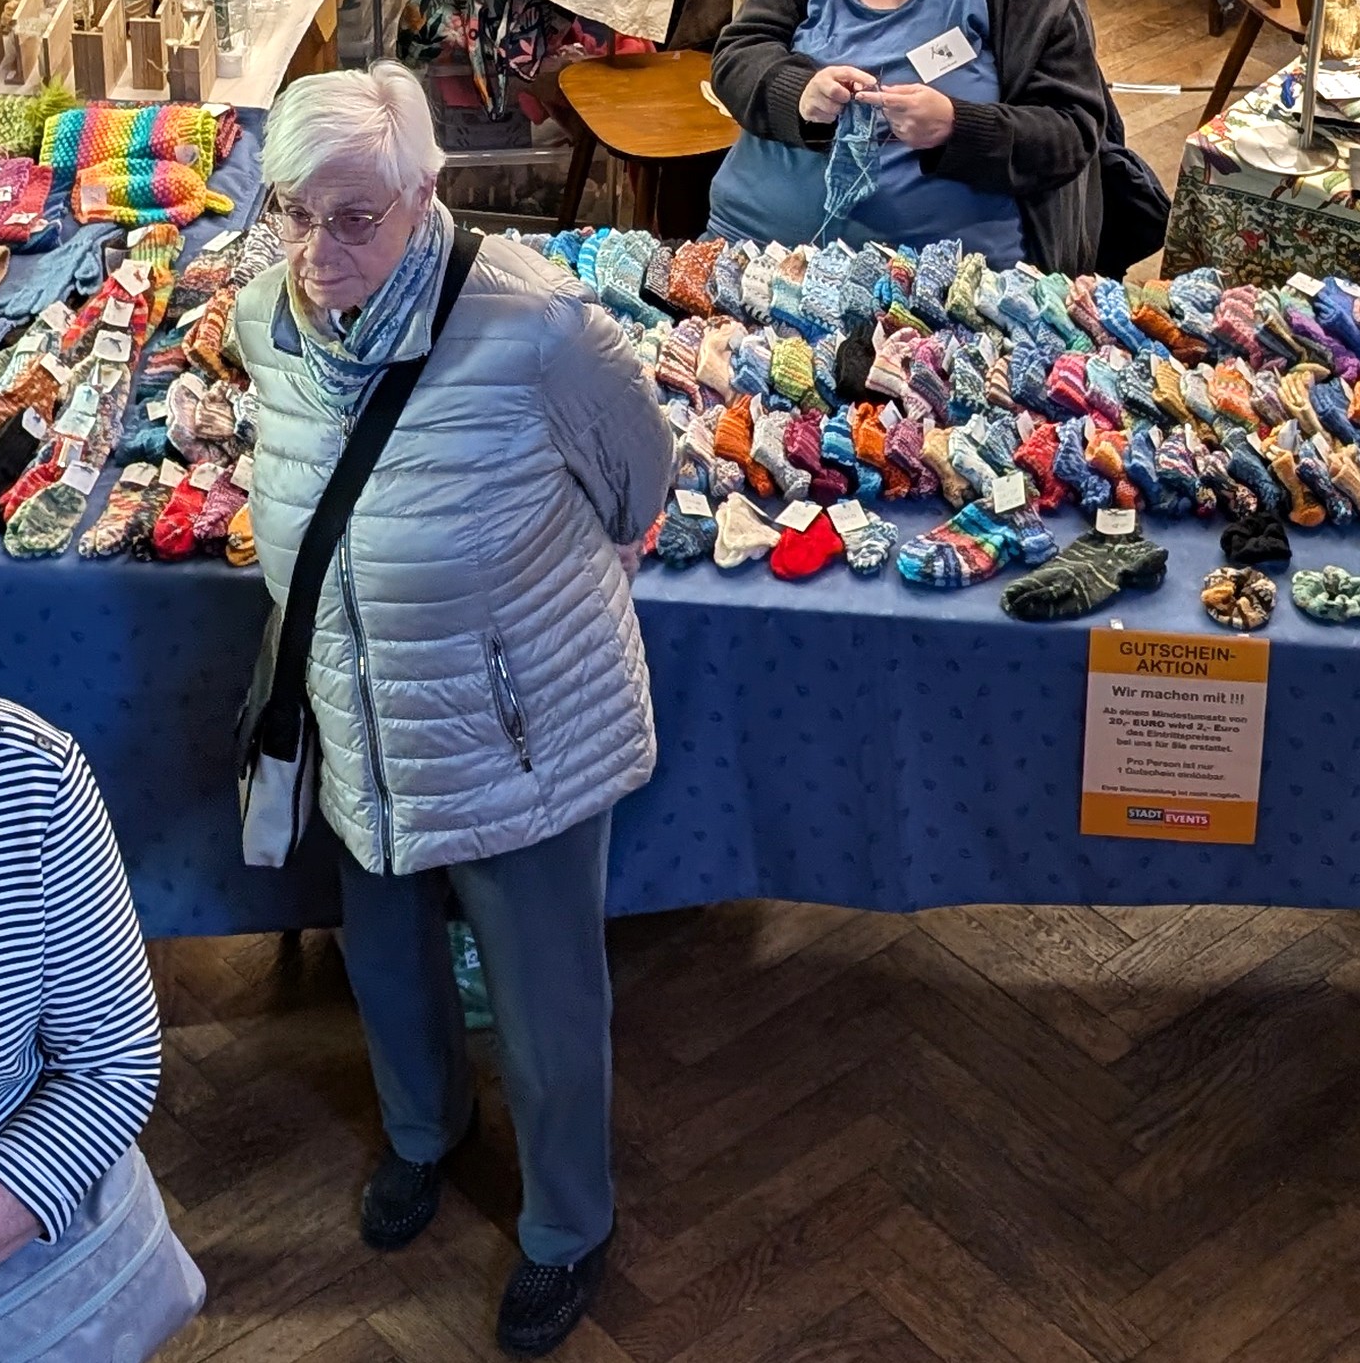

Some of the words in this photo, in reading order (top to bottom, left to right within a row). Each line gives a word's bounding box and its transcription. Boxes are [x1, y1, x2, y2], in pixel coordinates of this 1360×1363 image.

[1120, 642, 1236, 661] GUTSCHEIN-
[1136, 659, 1208, 676] AKTION
[1112, 685, 1137, 697] Wir
[1141, 687, 1199, 702] machen
[1203, 691, 1225, 703] mit
[1103, 707, 1117, 715] Ab
[1119, 708, 1149, 717] einem
[1152, 710, 1226, 722] Mindestumsatz
[1126, 728, 1144, 737] des
[1133, 719, 1165, 728] EURO
[1169, 721, 1193, 730] wird
[1214, 724, 1240, 733] Euro
[1117, 738, 1131, 746] bei
[1155, 740, 1168, 749] für
[1172, 742, 1186, 750] Sie
[1127, 758, 1144, 766] Pro
[1146, 758, 1181, 768] Person
[1183, 761, 1195, 769] ist
[1125, 767, 1175, 778] Gutschein
[1128, 808, 1163, 819] STADT
[1165, 814, 1208, 825] EVENTS
